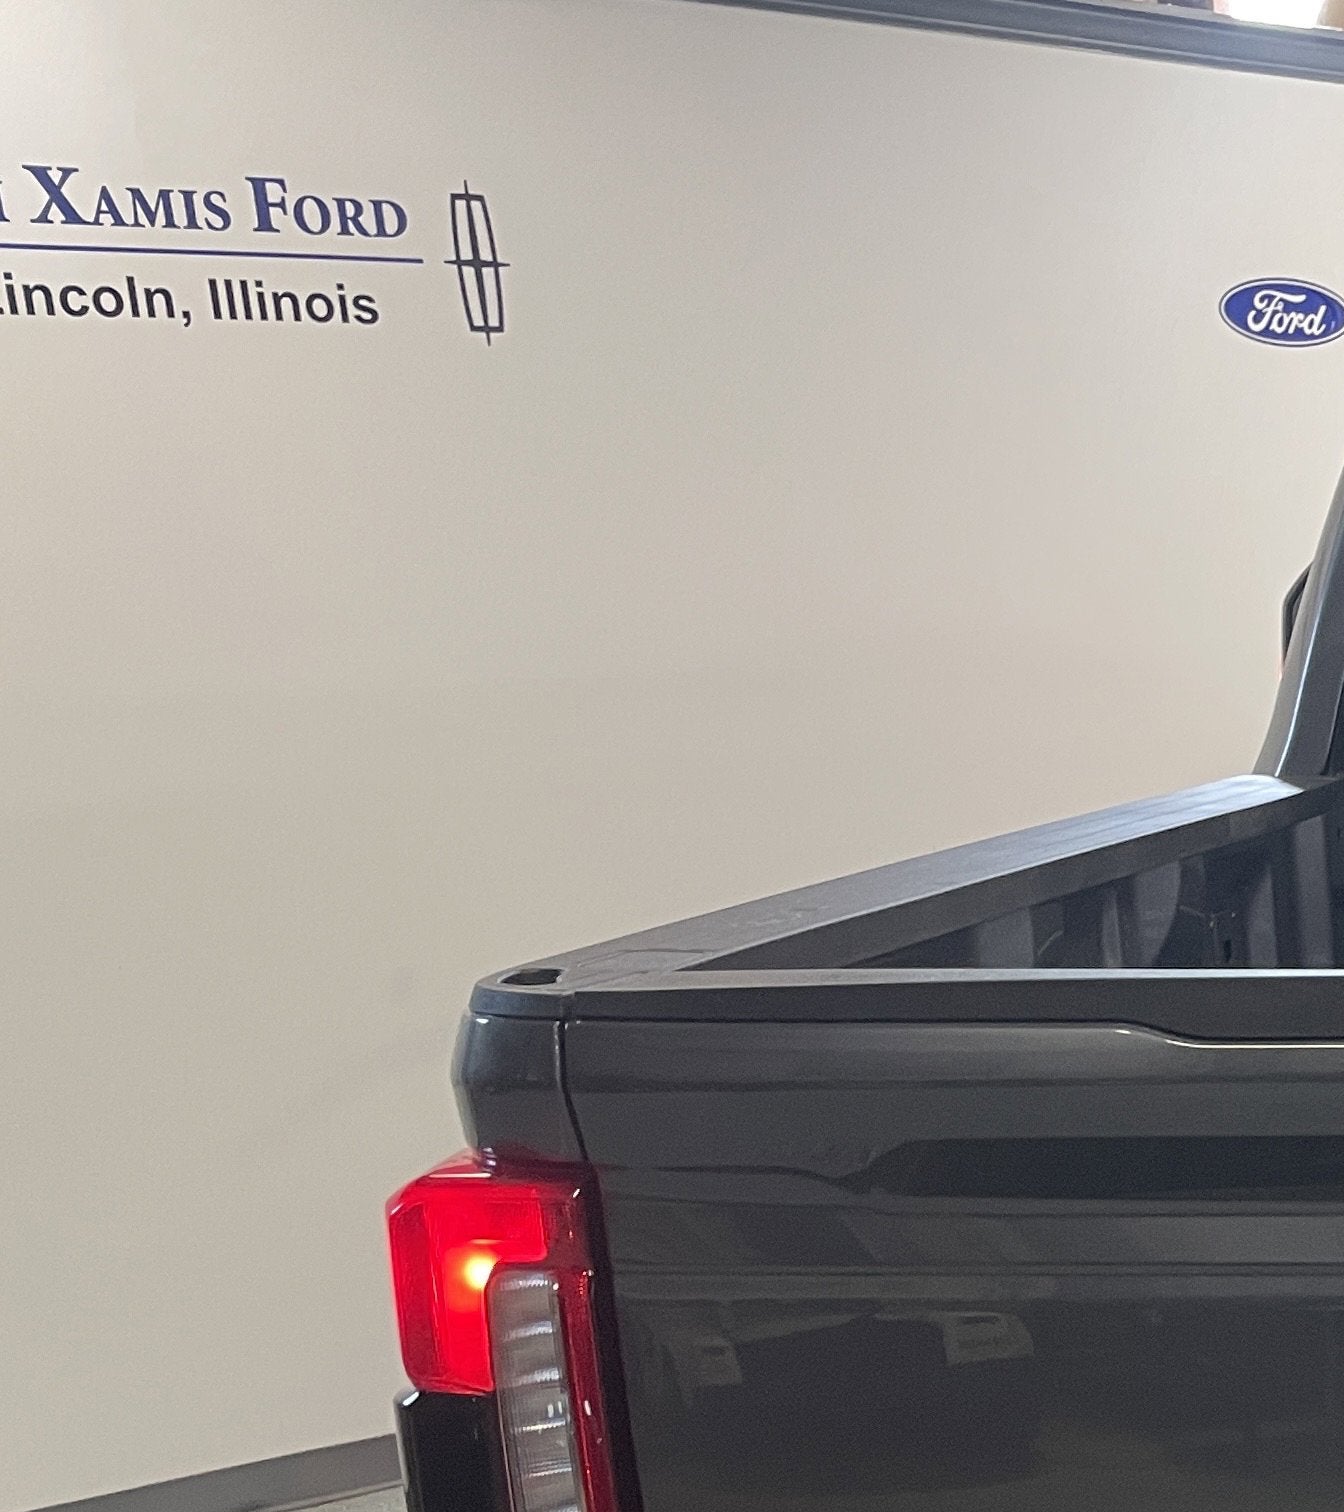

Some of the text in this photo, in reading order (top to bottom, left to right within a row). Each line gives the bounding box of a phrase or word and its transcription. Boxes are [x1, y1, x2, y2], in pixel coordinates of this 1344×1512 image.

[22, 164, 232, 232] XAMIS
[244, 176, 409, 238] FORD
[207, 277, 380, 325] Illinois
[1246, 289, 1328, 337] Ford
